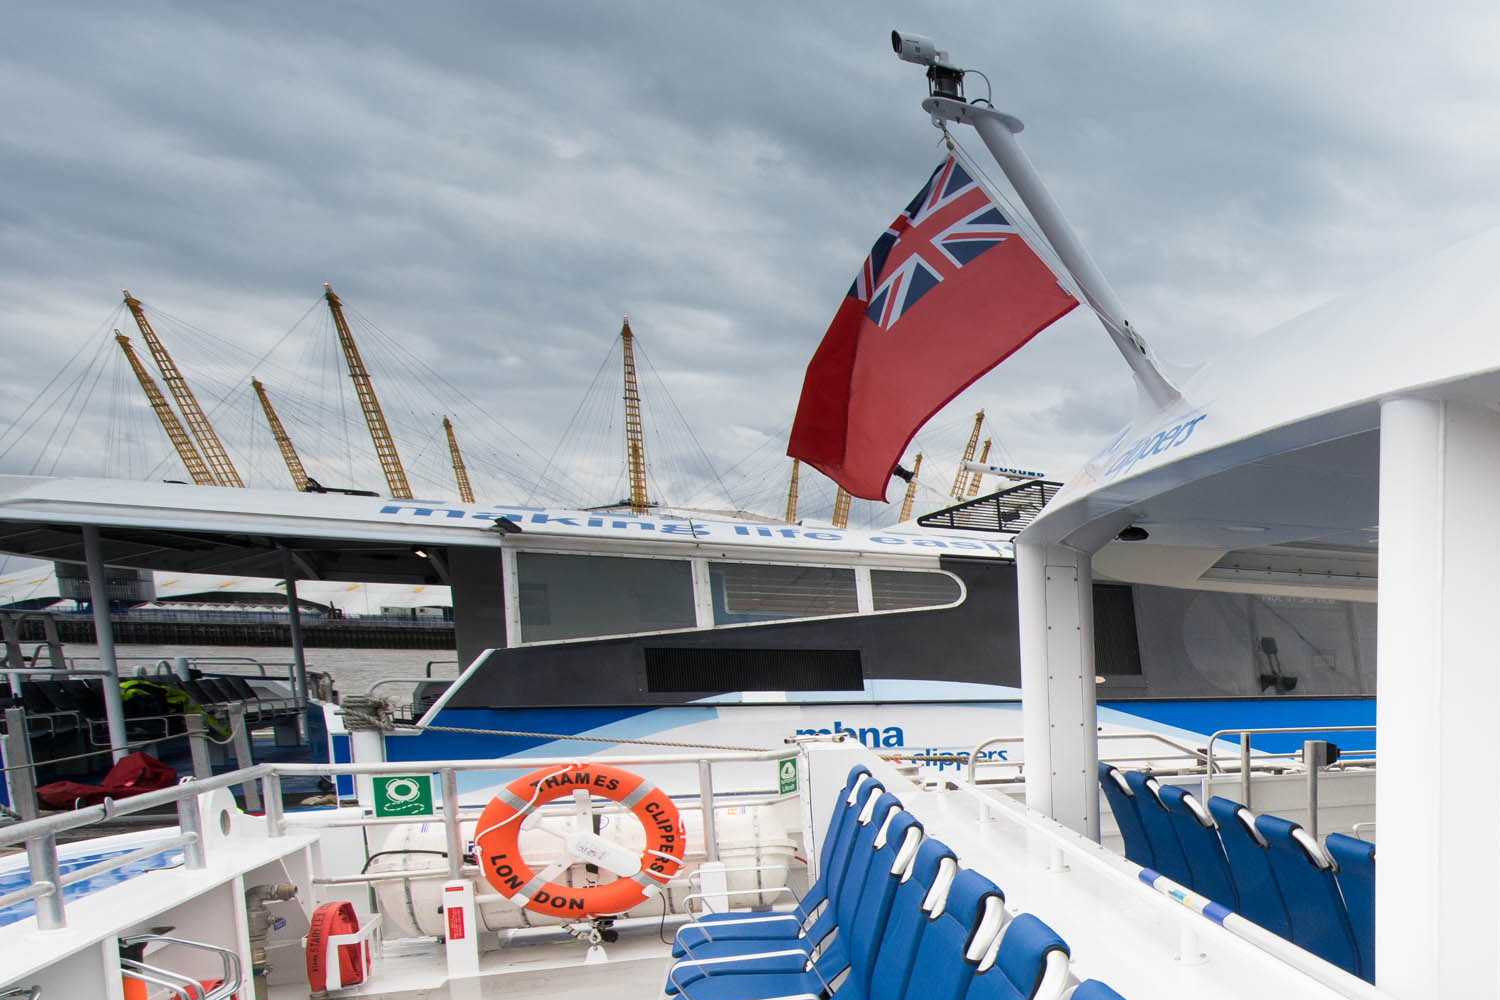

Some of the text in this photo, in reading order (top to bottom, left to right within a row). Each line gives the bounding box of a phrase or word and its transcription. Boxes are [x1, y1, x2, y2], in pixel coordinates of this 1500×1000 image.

[379, 504, 711, 537] making
[734, 525, 843, 541] life
[911, 748, 1008, 771] clippers
[529, 772, 620, 793] THAMES
[645, 802, 675, 874] CLIPPERS
